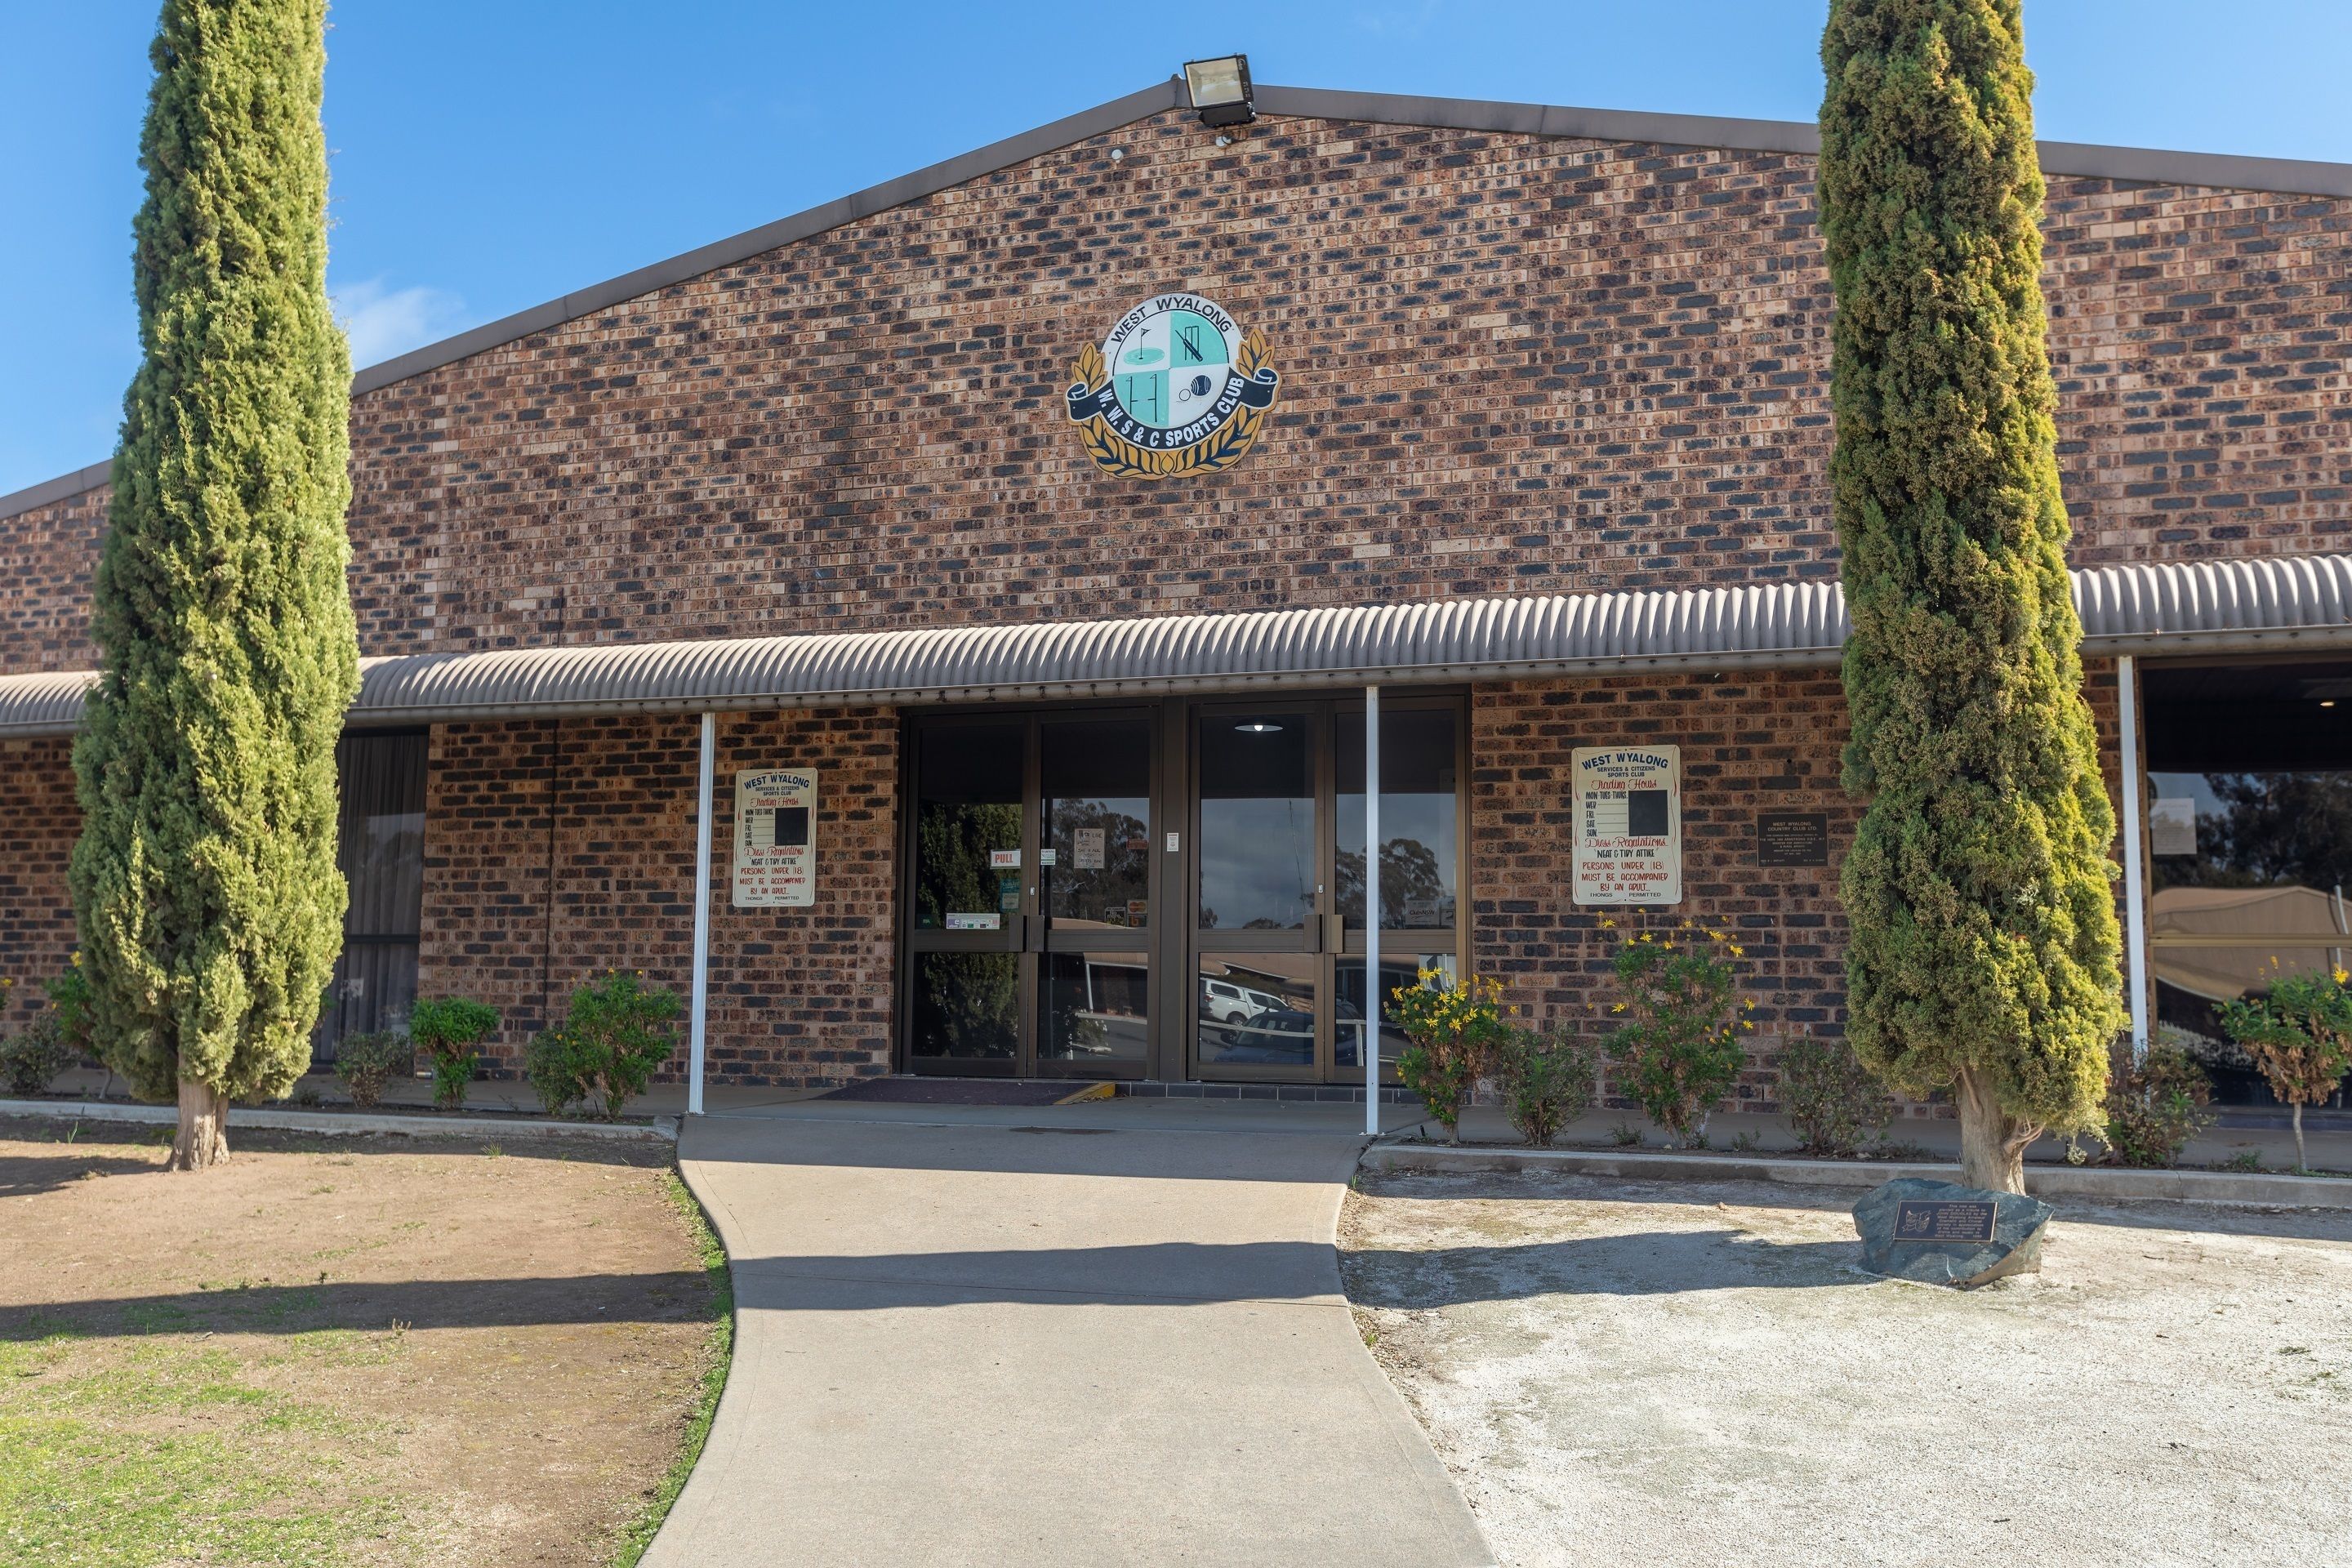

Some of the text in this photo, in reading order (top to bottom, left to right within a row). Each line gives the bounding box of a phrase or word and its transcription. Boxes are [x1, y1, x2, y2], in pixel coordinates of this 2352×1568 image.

[1111, 296, 1232, 344] WEST WYALONG
[1133, 430, 1144, 443] &
[1150, 433, 1160, 447] C
[1165, 412, 1220, 447] SPORTS
[1217, 376, 1245, 414] CLUB
[1582, 753, 1668, 770] WEST WYALONG
[744, 774, 810, 790] WEST WYALONG
[995, 853, 1013, 863] PULL
[1614, 849, 1619, 858] &
[1620, 849, 1633, 858] TIDY
[771, 866, 789, 875] UNDER
[1582, 862, 1615, 871] PERSONS
[1621, 862, 1645, 871] UNDER
[758, 877, 765, 885] BE
[770, 877, 806, 885] ACCOMPANIED
[1581, 872, 1668, 881] MUST BE ACCOMPANIED
[1600, 883, 1610, 892] BY
[1614, 883, 1624, 891] AN
